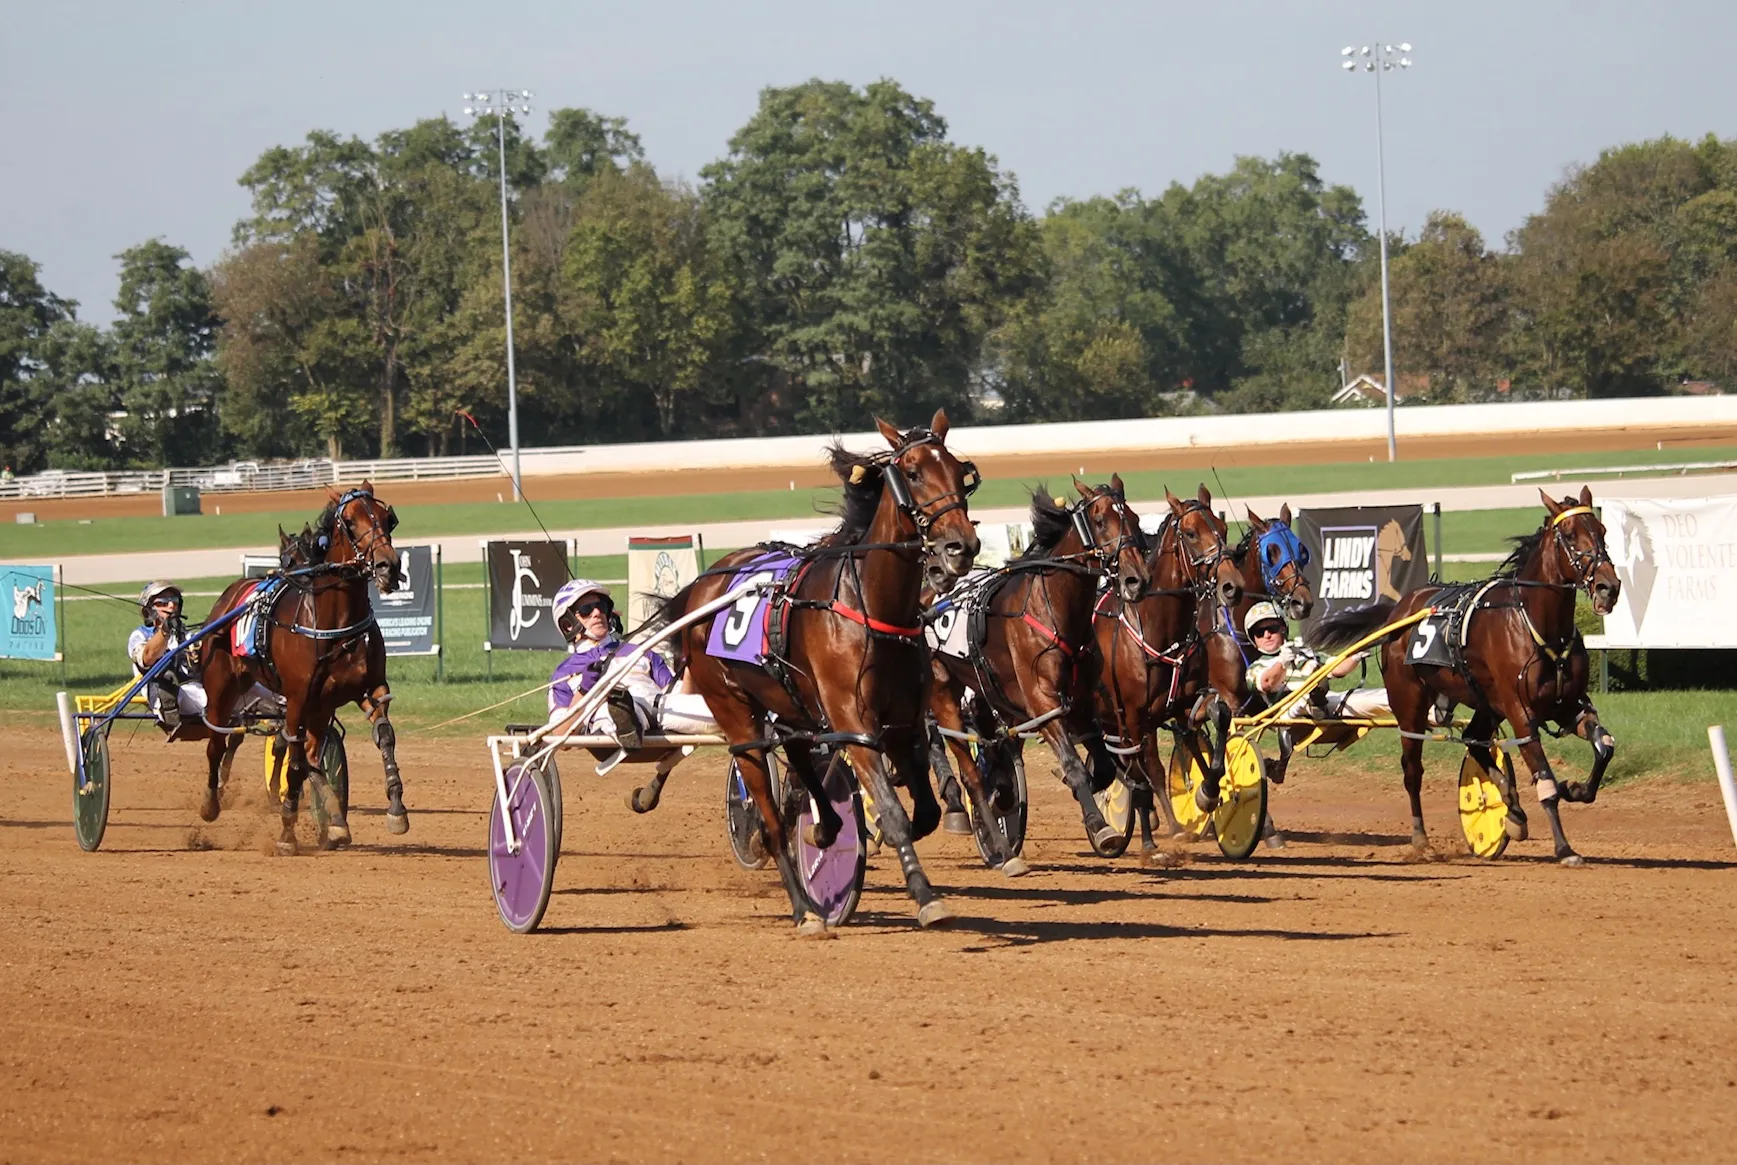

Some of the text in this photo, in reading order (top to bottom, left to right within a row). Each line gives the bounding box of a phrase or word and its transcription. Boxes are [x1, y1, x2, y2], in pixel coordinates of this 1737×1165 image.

[1662, 513, 1698, 538] DEO
[1323, 536, 1375, 569] LINDY
[1665, 543, 1736, 569] VOLENTE
[1319, 569, 1374, 599] FARMS
[1667, 575, 1717, 601] FARMS
[1412, 612, 1442, 659] 5
